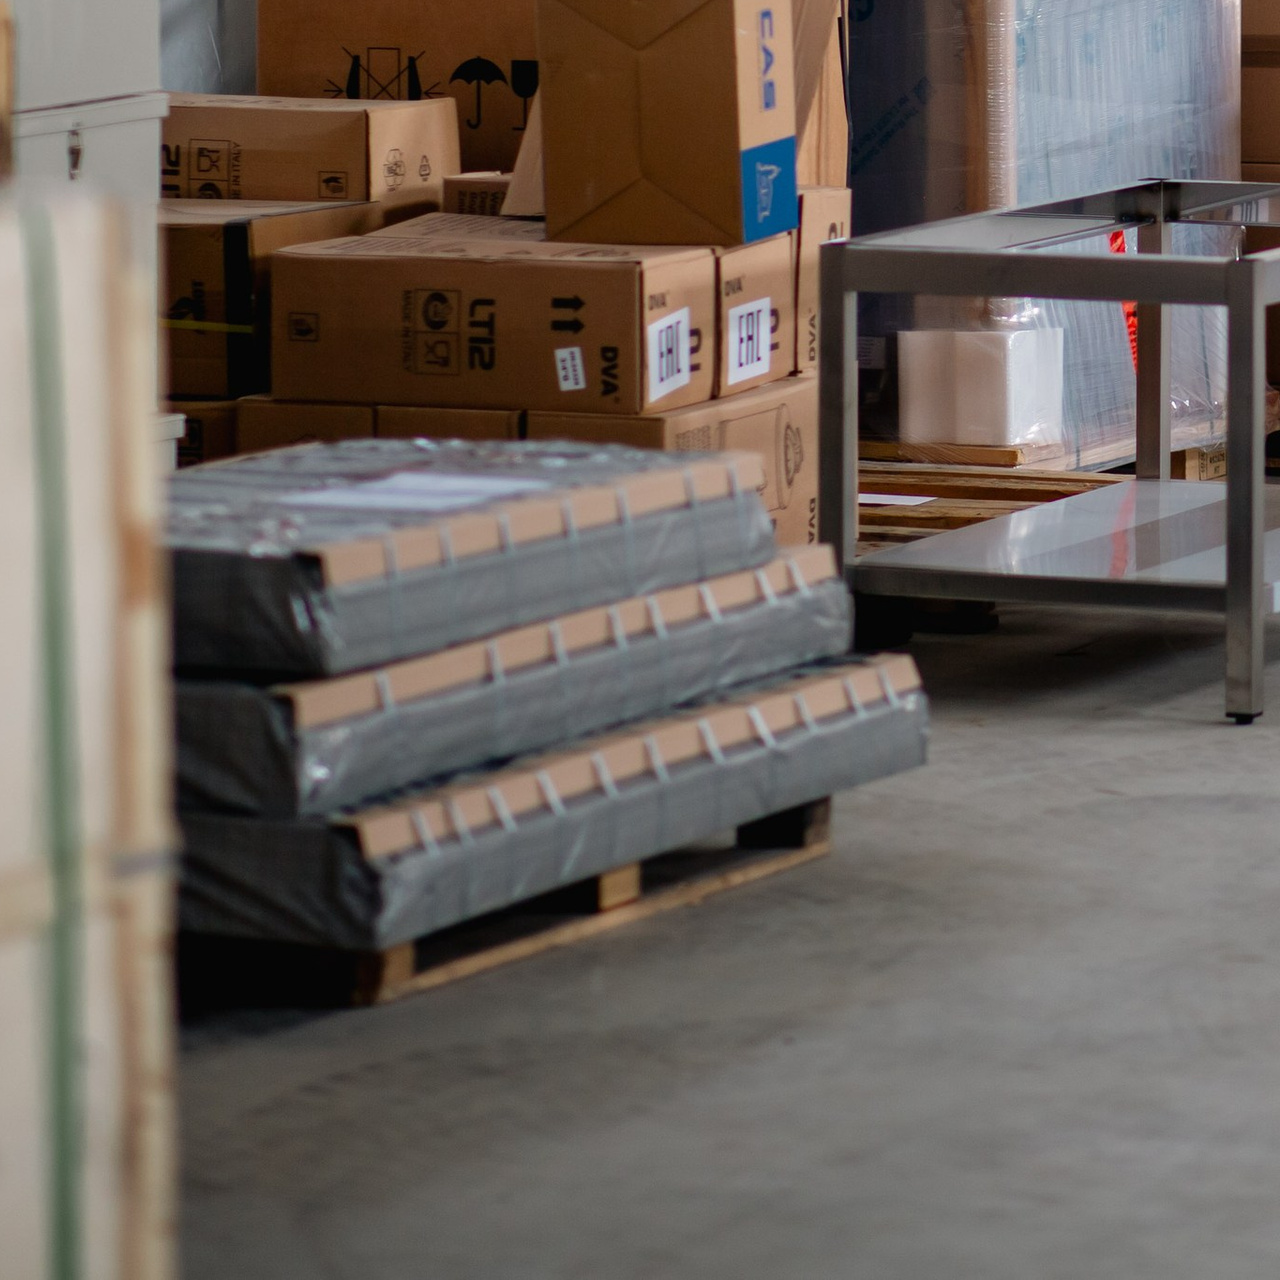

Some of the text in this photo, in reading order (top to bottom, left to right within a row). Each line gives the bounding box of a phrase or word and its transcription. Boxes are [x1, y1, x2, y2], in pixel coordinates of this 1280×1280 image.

[648, 294, 668, 311] DVA
[724, 277, 743, 297] DVA
[808, 314, 817, 362] DVA
[601, 346, 619, 396] DVA
[808, 498, 816, 544] DVA
